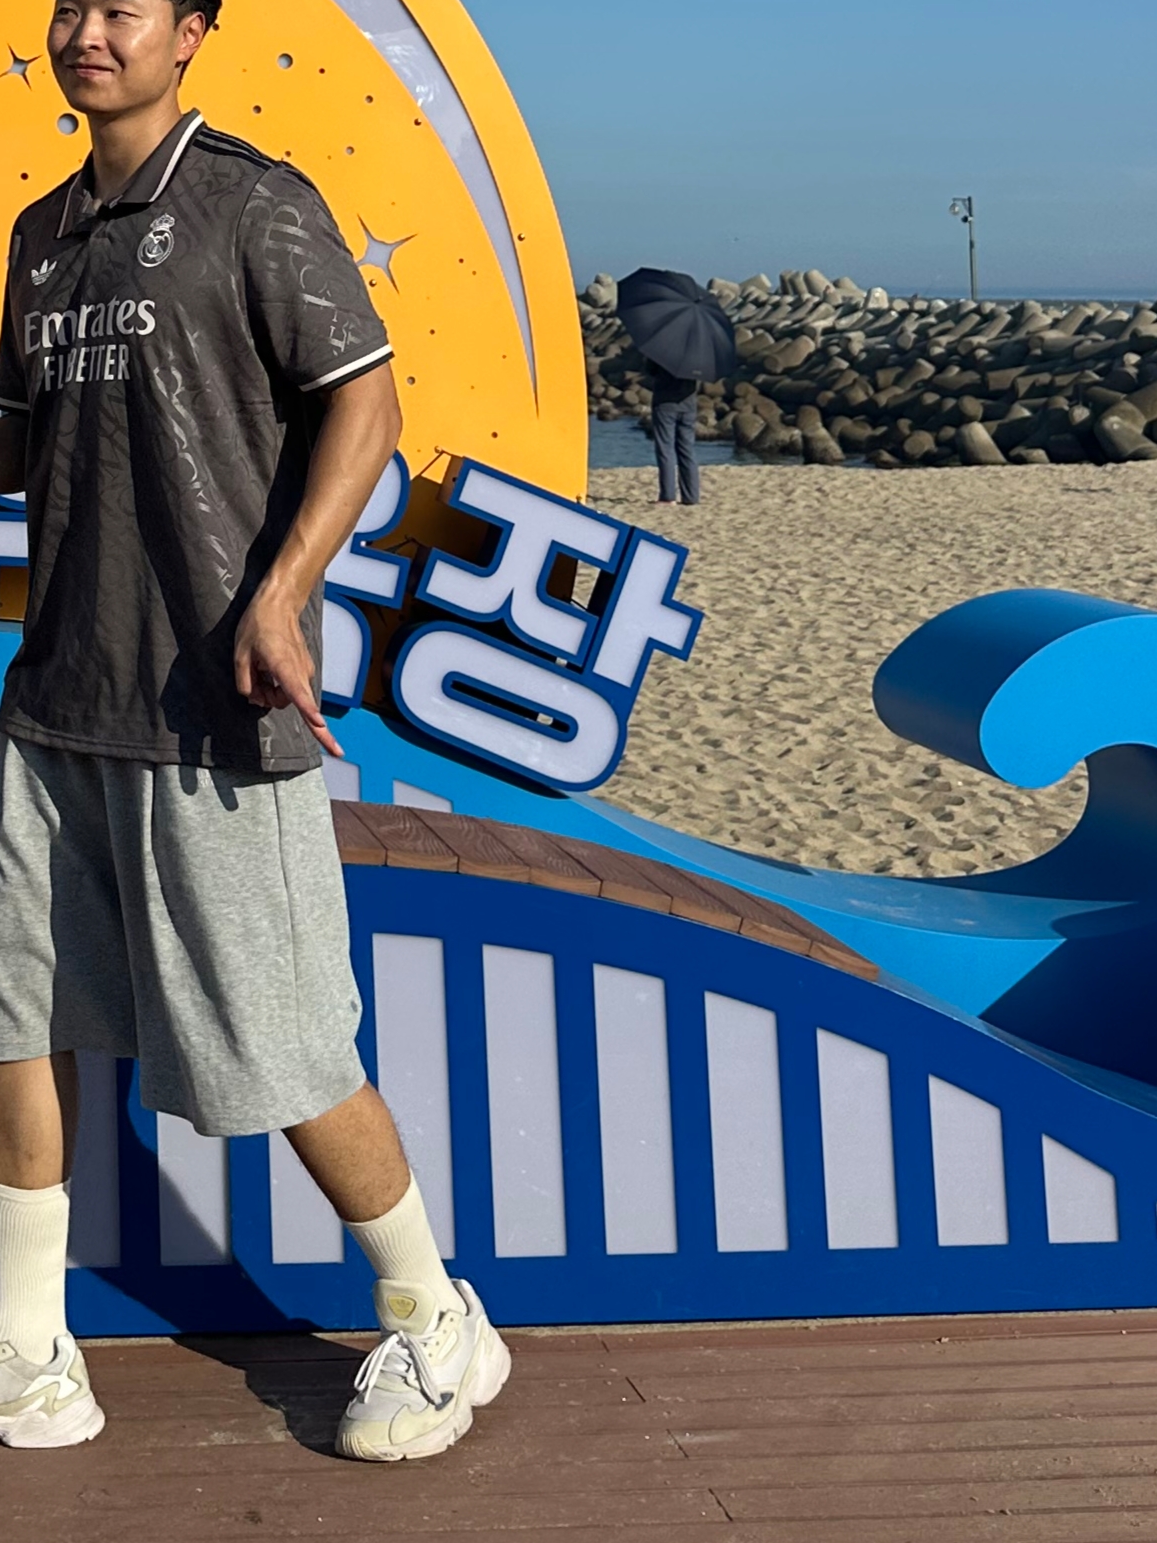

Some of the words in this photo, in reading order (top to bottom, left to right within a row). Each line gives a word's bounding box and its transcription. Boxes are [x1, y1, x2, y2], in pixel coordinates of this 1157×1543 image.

[24, 294, 156, 355] Emrates
[43, 355, 64, 392] FL
[64, 343, 131, 384] BETTER
